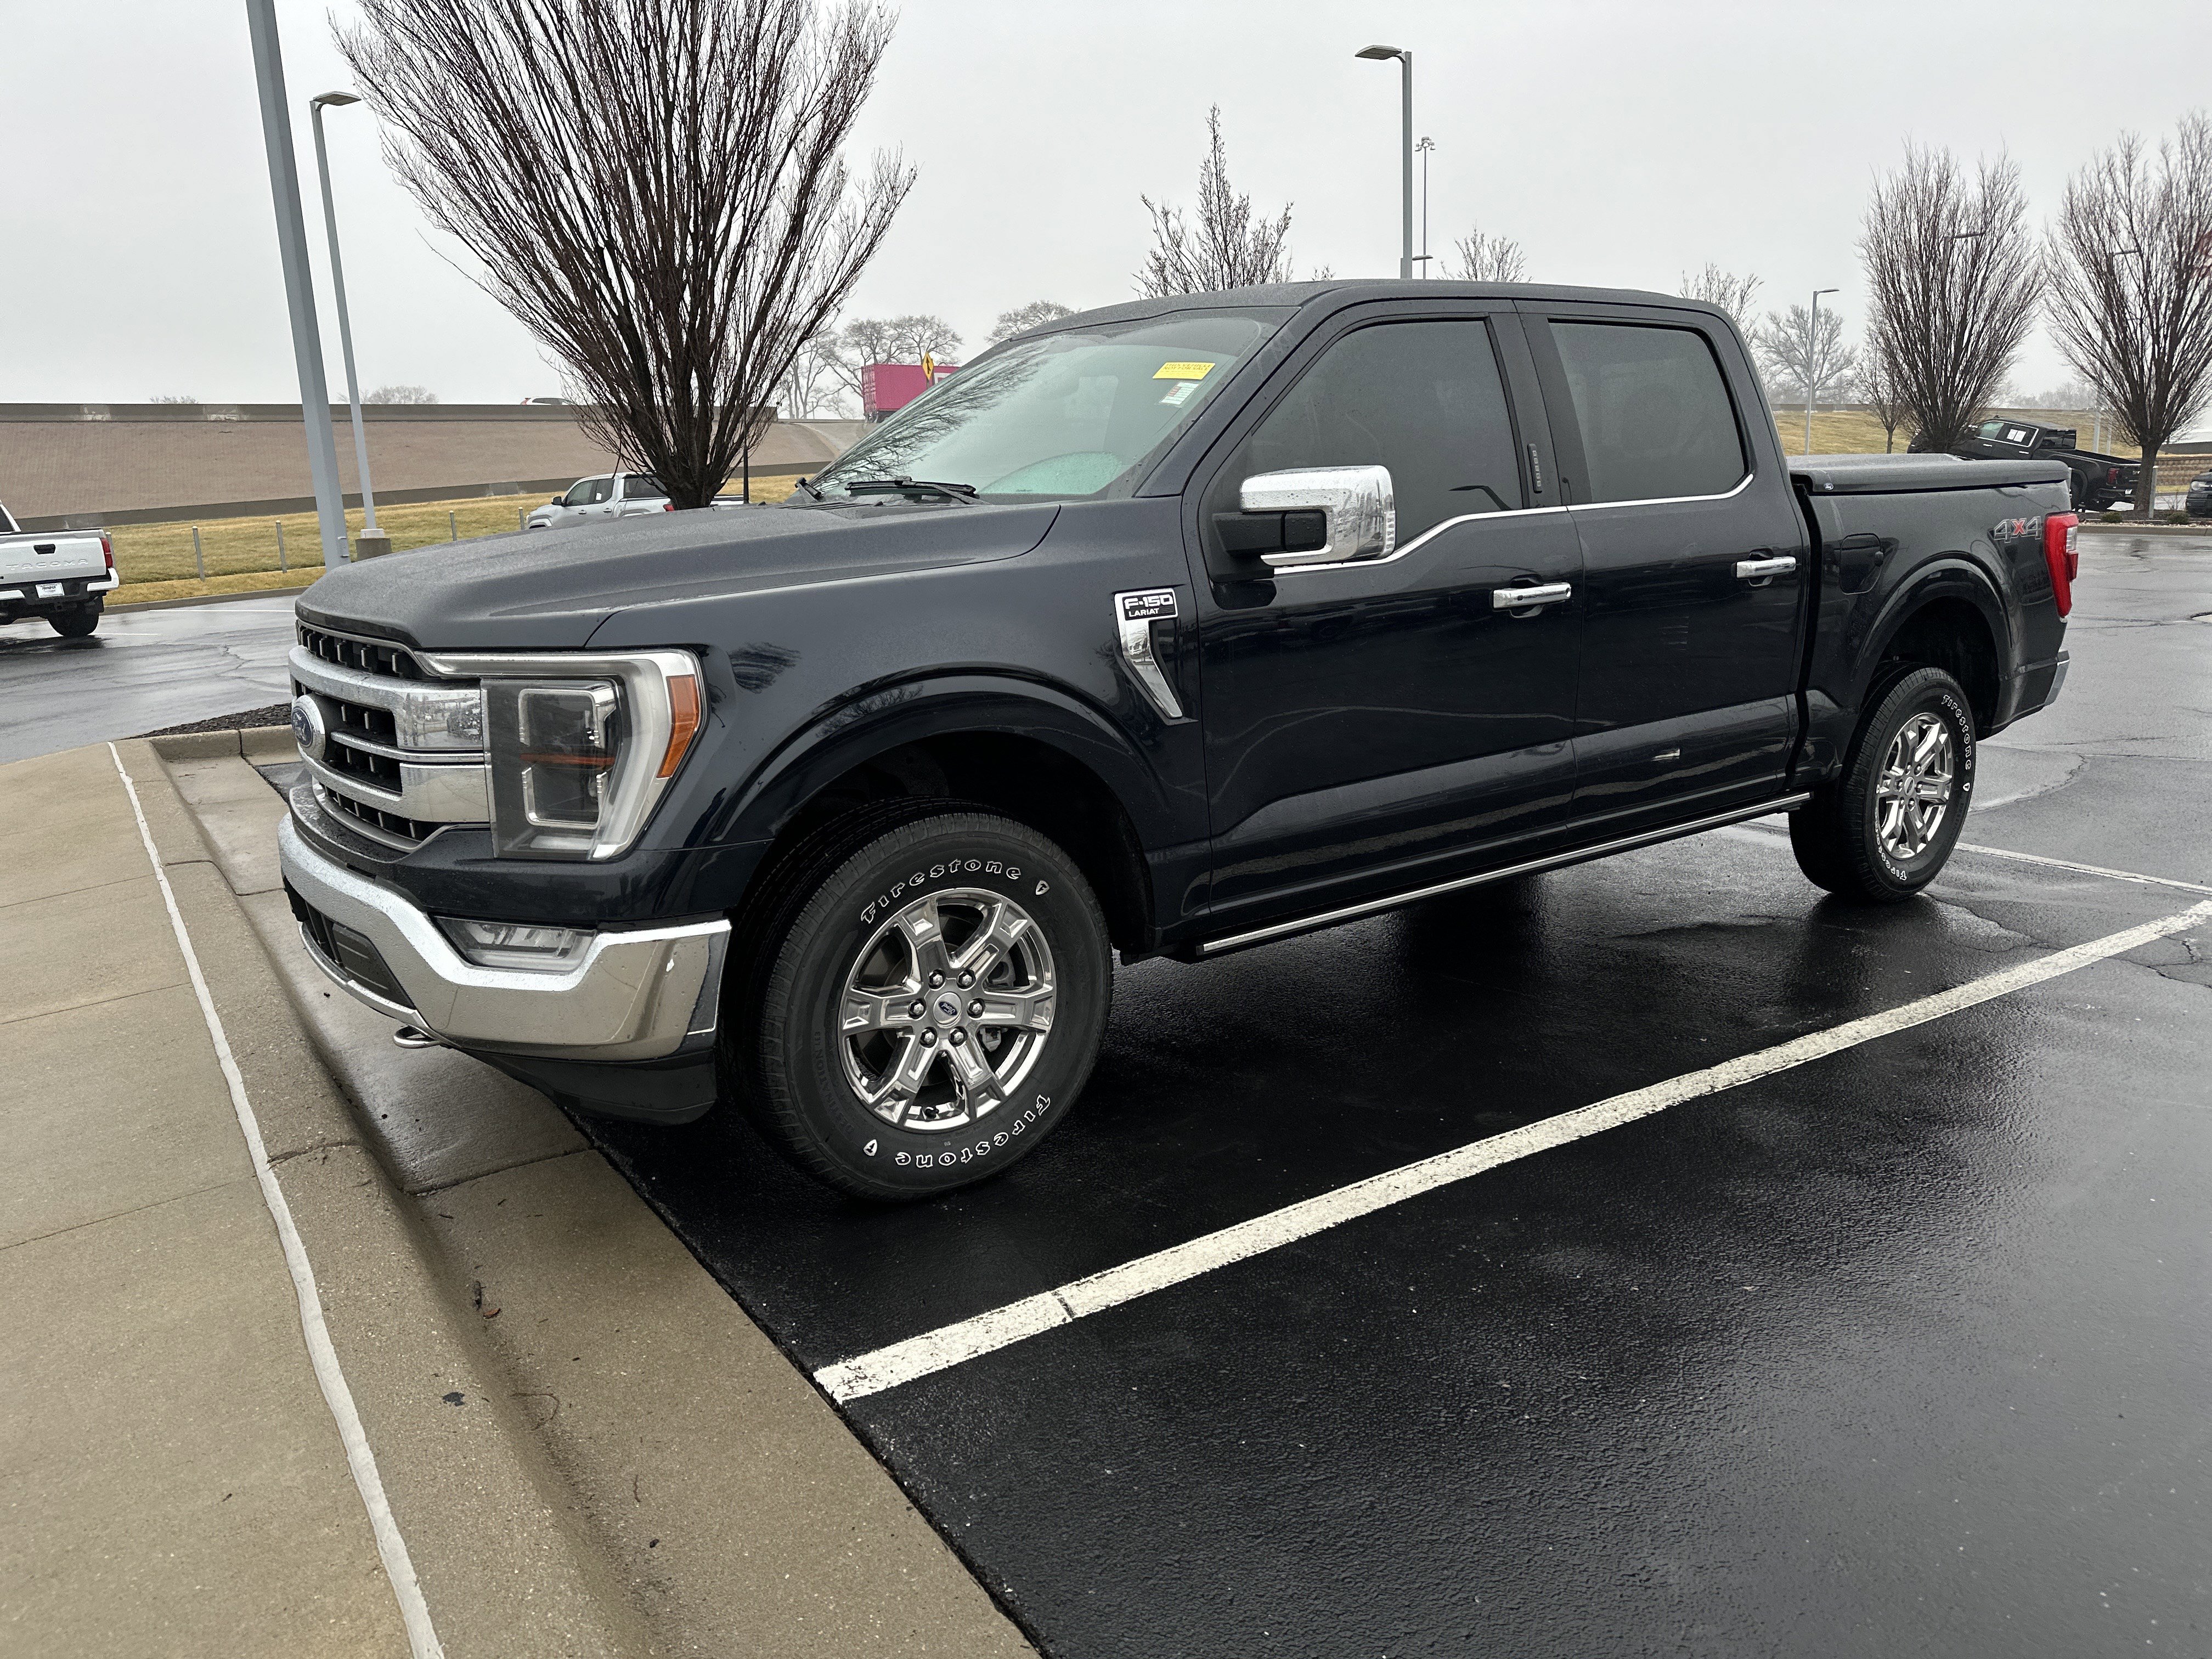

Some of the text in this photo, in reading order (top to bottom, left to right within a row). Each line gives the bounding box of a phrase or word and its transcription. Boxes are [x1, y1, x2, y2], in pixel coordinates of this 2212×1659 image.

[5, 558, 89, 571] TACOMA
[1124, 594, 1173, 609] F-150
[1128, 608, 1159, 617] LARIAT
[1941, 695, 1972, 770] Firestone
[861, 859, 1022, 924] Firestone
[895, 1094, 1051, 1168] Firestone
